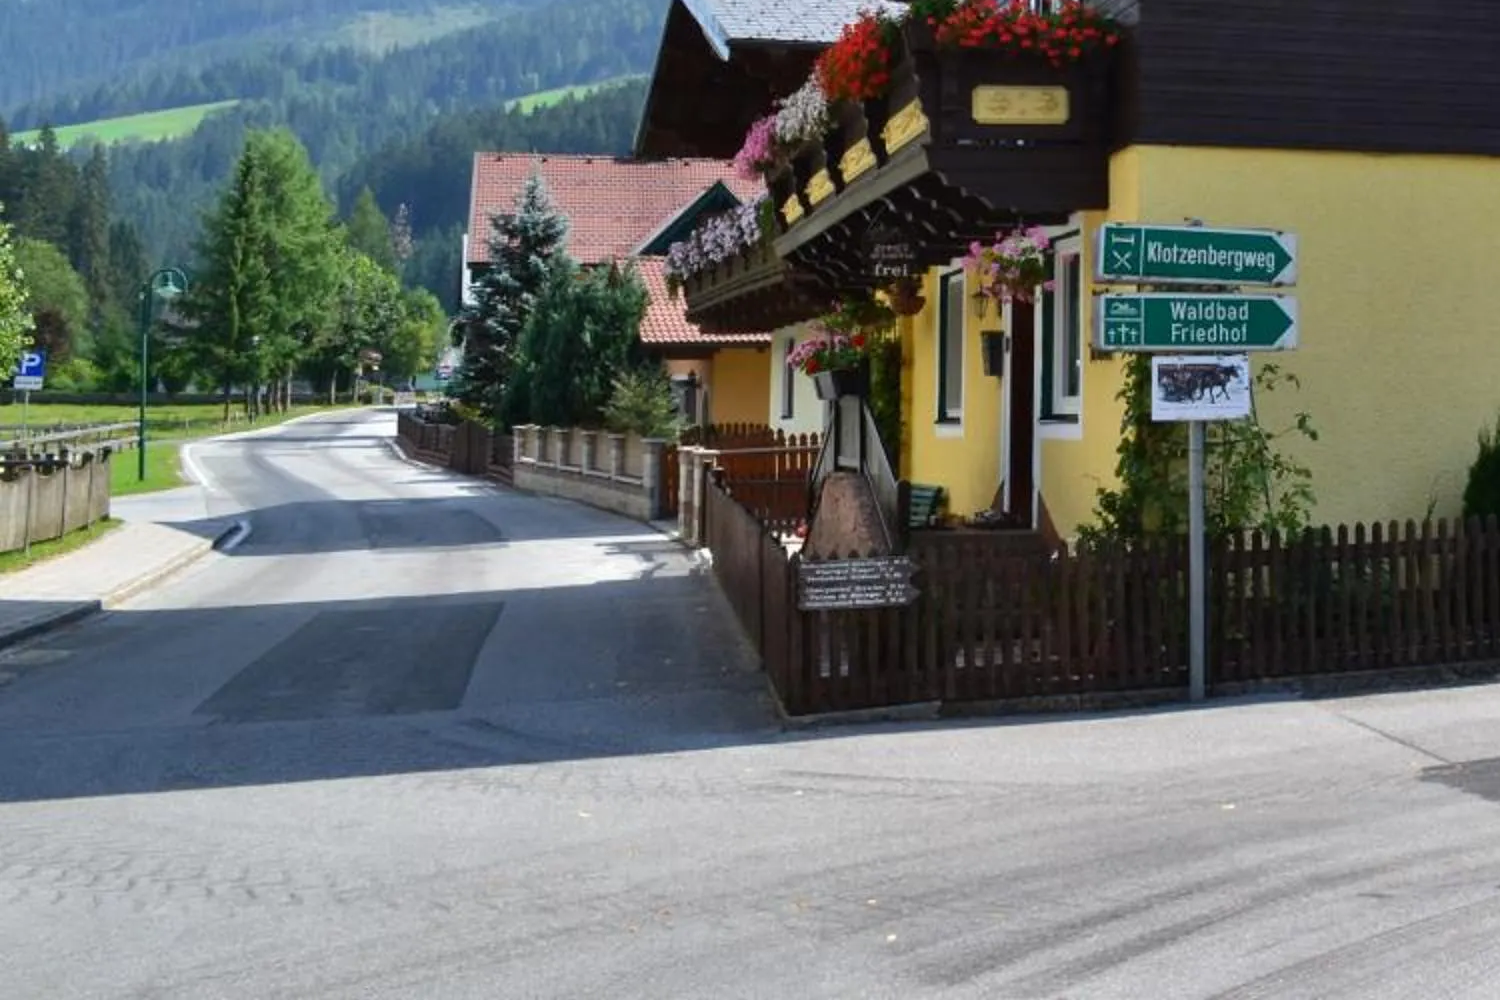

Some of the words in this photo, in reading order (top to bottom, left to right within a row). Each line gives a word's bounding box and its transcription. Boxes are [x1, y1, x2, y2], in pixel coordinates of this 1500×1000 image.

[1147, 240, 1276, 272] Klotzenbergweg
[1170, 301, 1249, 321] Waldbad
[1170, 323, 1247, 342] Friedhof
[21, 353, 41, 375] P
